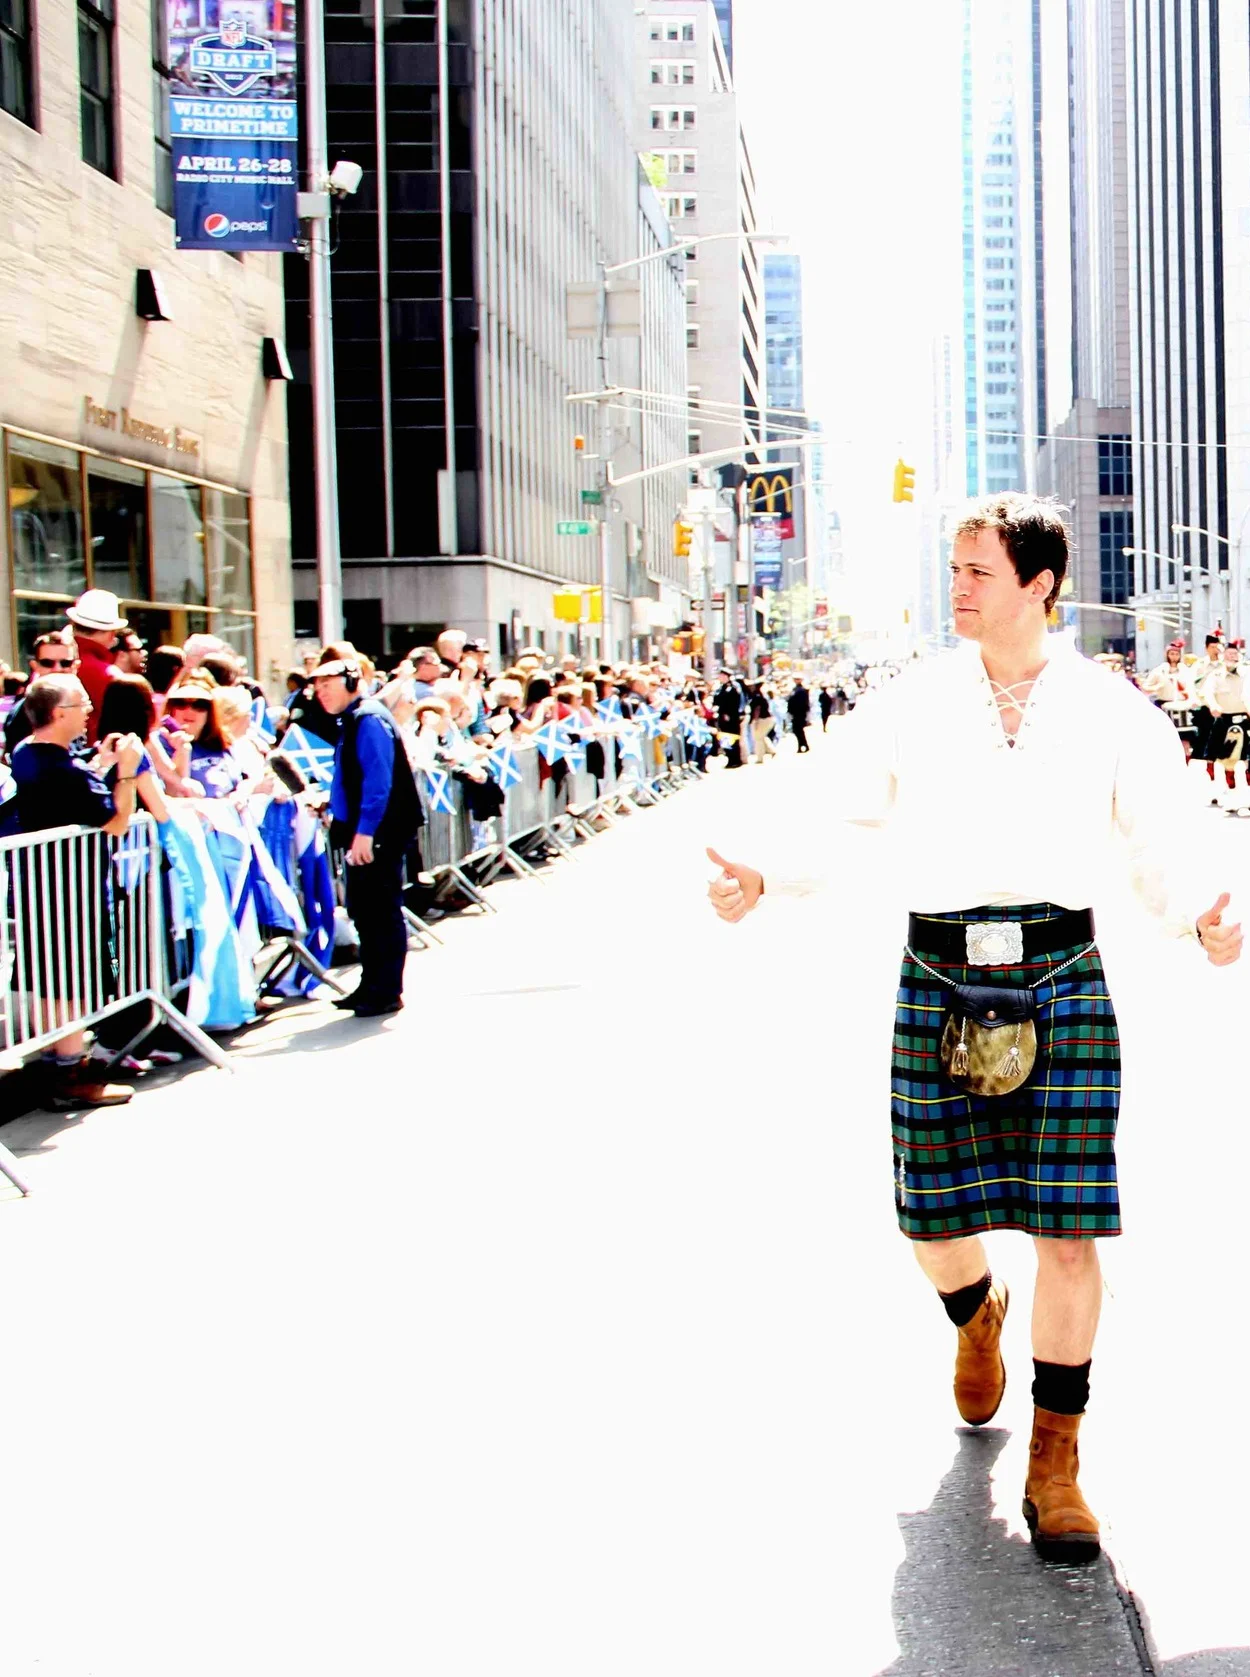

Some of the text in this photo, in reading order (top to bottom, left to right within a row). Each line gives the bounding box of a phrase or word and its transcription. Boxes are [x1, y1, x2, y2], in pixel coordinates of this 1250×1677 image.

[198, 52, 270, 68] DRAFT
[173, 101, 294, 120] WELCOME TO
[181, 118, 288, 135] PRIMETIME
[178, 155, 292, 173] APRIL 26-28
[176, 173, 295, 185] RADIO CITY MUSIC HALL
[230, 219, 268, 233] pepsi
